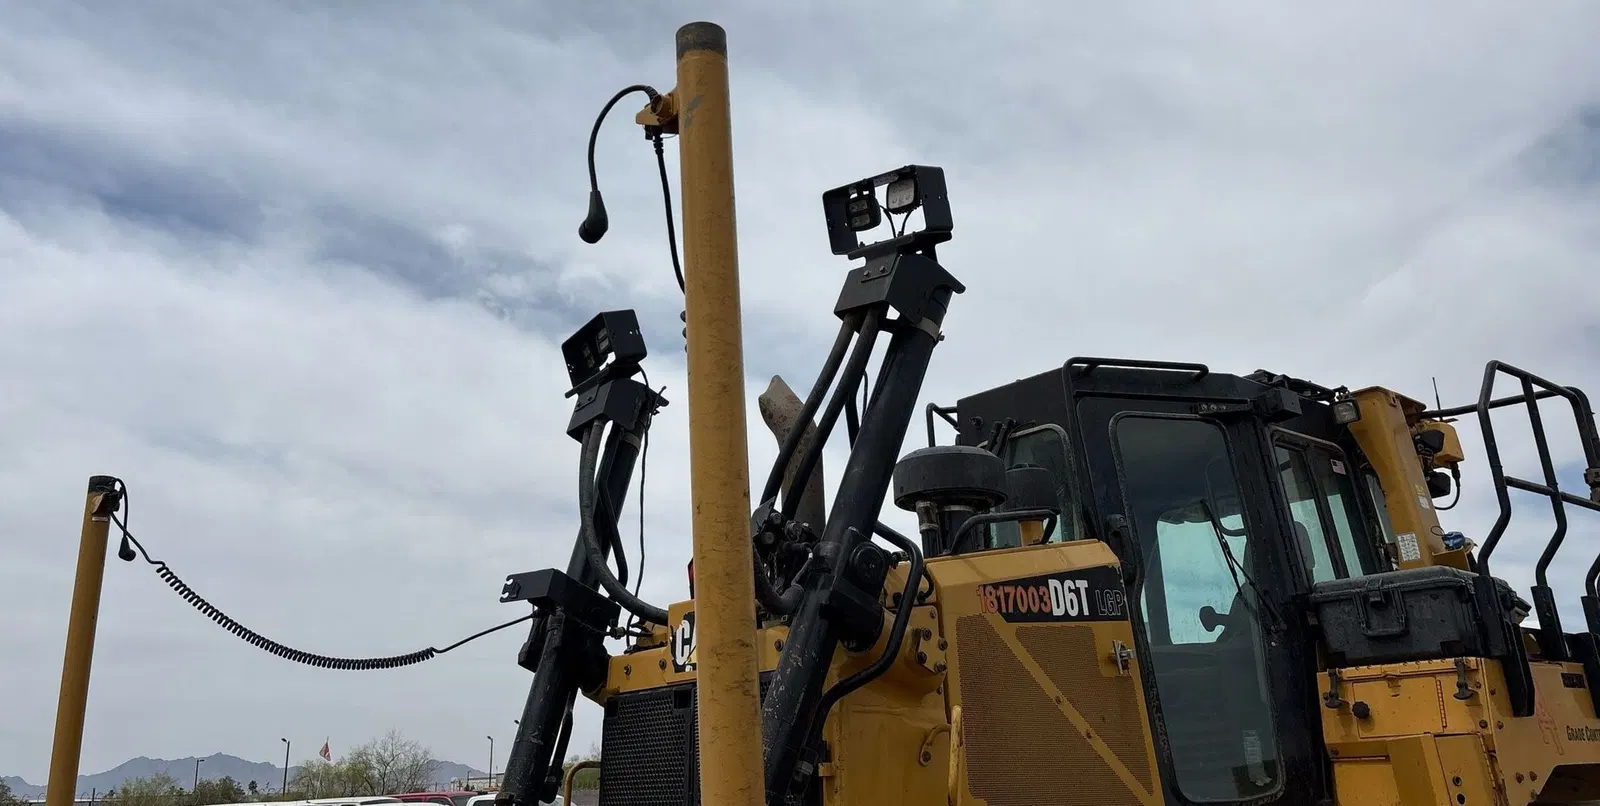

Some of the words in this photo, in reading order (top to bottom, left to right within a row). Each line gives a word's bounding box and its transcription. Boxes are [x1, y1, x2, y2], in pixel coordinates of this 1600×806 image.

[976, 585, 1050, 614] 1817003
[1048, 579, 1089, 616] D6T
[1095, 590, 1124, 616] LGP
